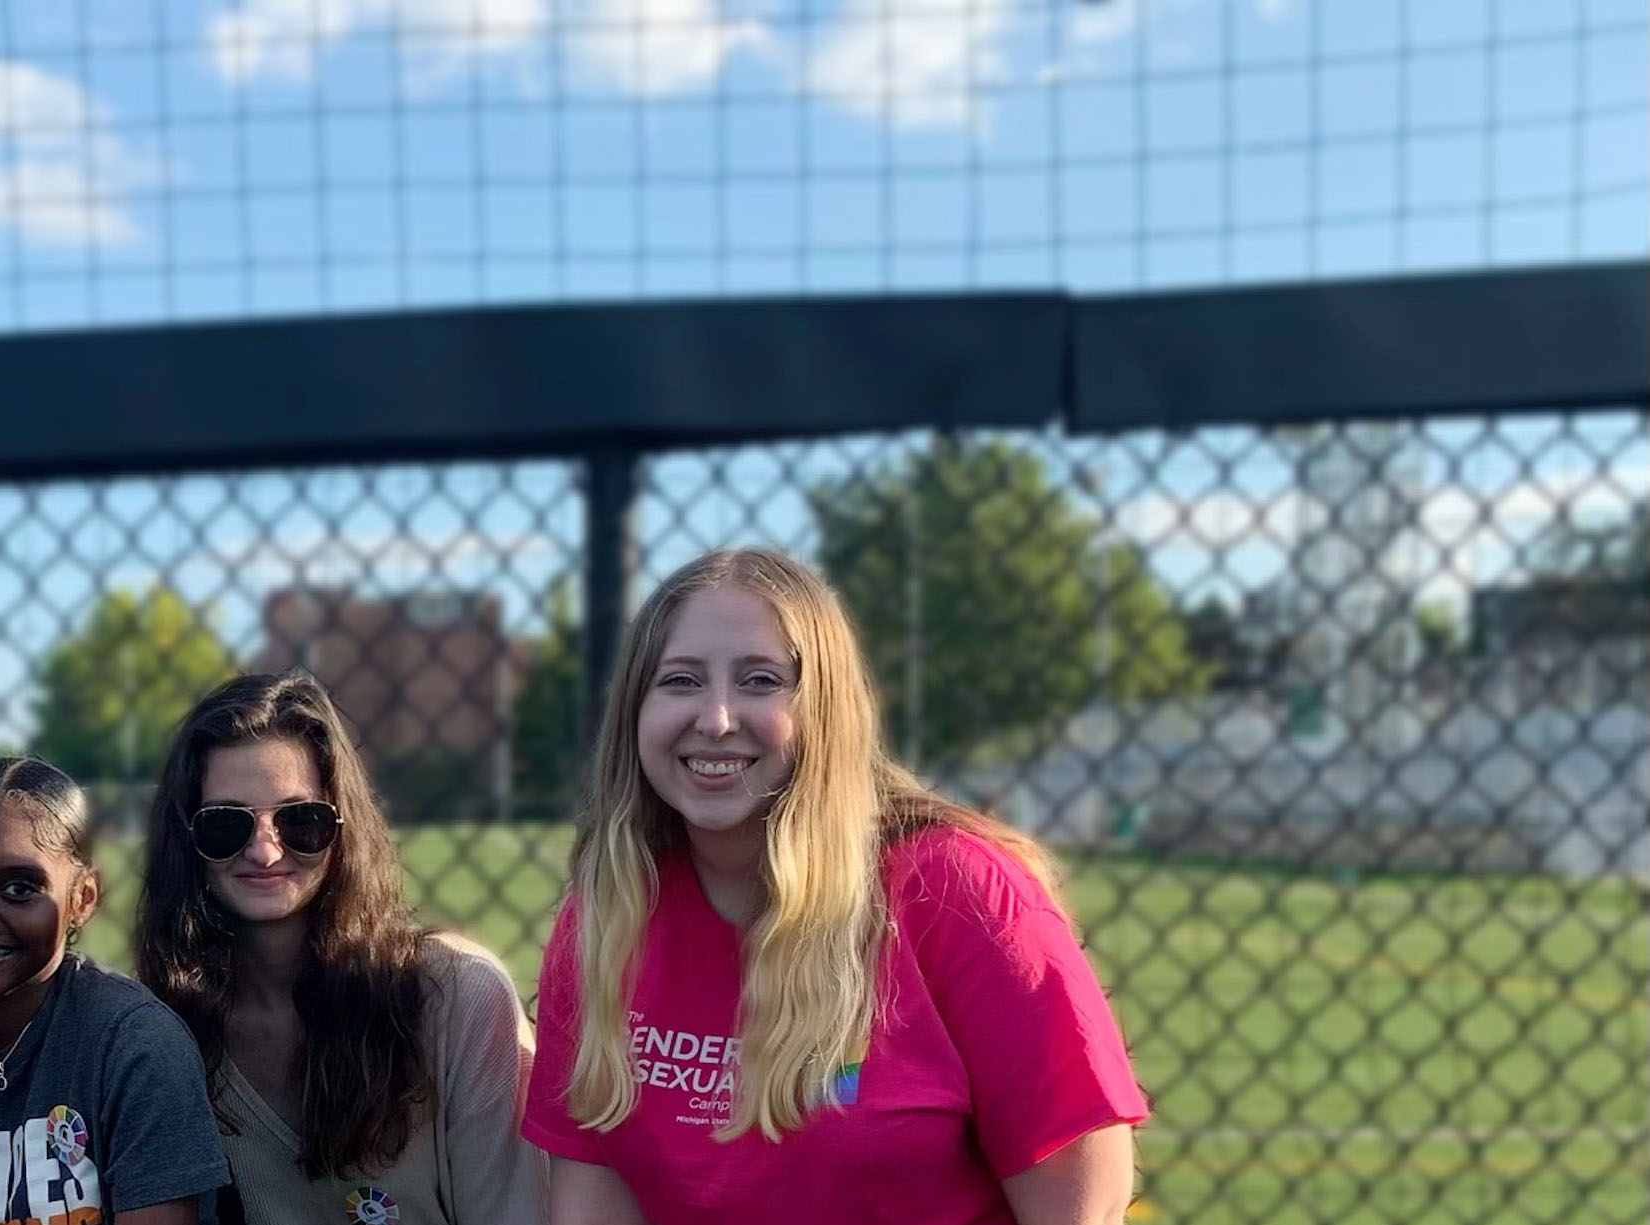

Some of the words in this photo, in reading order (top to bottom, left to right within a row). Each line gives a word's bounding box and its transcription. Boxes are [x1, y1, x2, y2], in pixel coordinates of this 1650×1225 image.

[629, 1026, 743, 1065] ENDER
[634, 1058, 735, 1094] SEXUA
[688, 1097, 730, 1112] Camp
